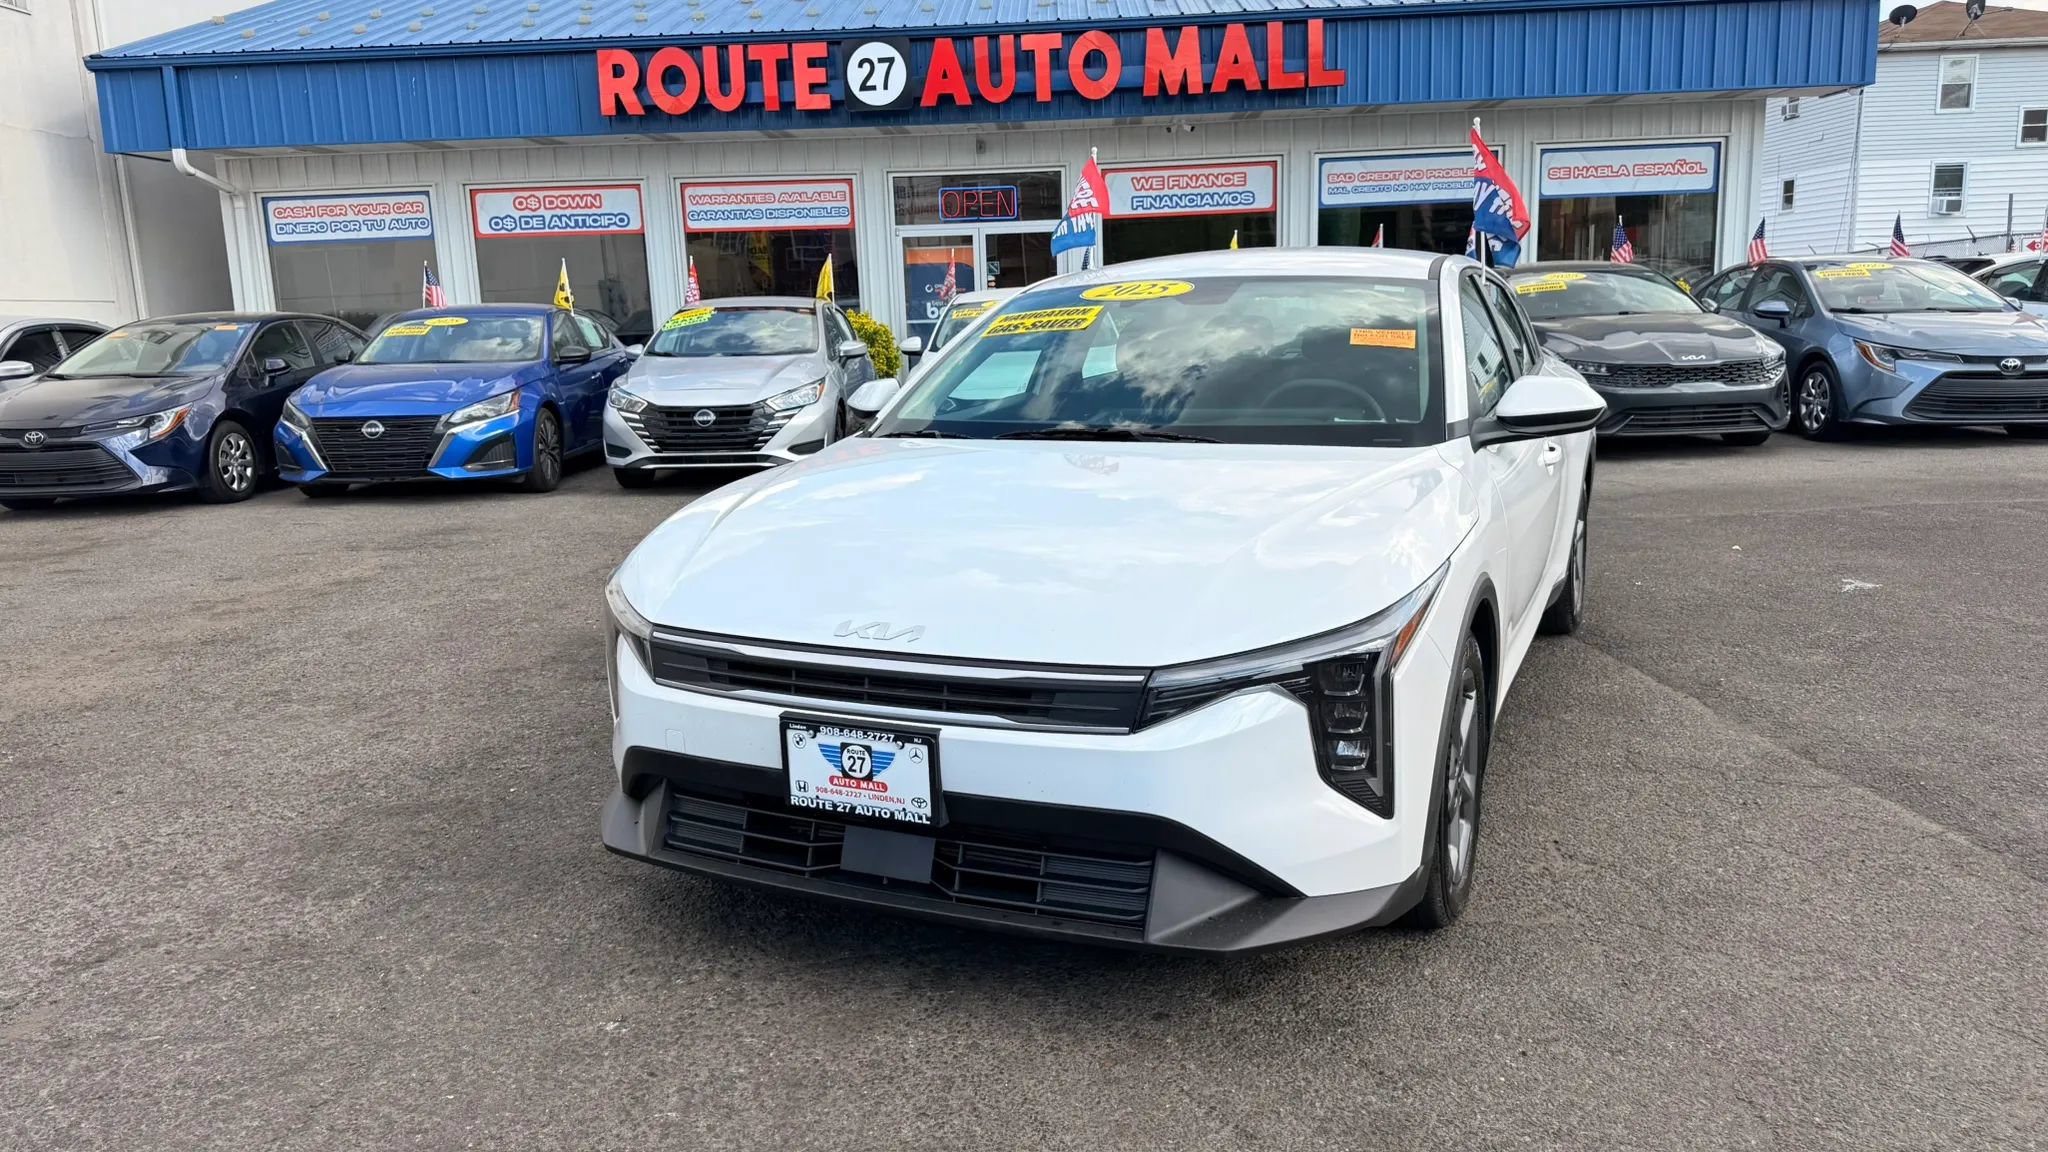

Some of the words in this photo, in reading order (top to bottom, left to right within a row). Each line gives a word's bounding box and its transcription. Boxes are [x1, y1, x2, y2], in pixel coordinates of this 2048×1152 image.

[596, 42, 832, 116] ROUTE
[857, 56, 896, 92] 27
[920, 30, 1122, 107] AUTO
[1143, 18, 1346, 97] MALL
[1328, 173, 1355, 184] BAD
[1357, 171, 1402, 182] CREDIT
[1404, 170, 1424, 180] NO
[1426, 167, 1475, 178] PROBLE
[1548, 168, 1571, 180] SE
[1573, 165, 1629, 179] HABLA
[1632, 158, 1707, 176] ESPAÑOL
[1131, 175, 1165, 191] WE
[1167, 172, 1247, 189] FINANCE
[1328, 186, 1350, 195] MAL
[1351, 184, 1392, 194] CREDITO
[1393, 184, 1408, 192] NO
[1410, 183, 1431, 191] HAY
[544, 193, 602, 210] DOWN
[689, 192, 775, 206] WARRANTIES
[778, 190, 847, 204] AVAILABLE
[941, 191, 1015, 217] OPEN
[1131, 191, 1255, 210] FINANCIAMOS
[274, 205, 315, 219] CASH
[318, 204, 347, 217] FOR
[351, 202, 390, 215] YOUR
[393, 201, 424, 214] CAR
[688, 207, 764, 221] GARANTIAS
[765, 206, 849, 219] DISPONIBLES
[276, 221, 329, 235] DINERO
[330, 219, 361, 233] POR
[363, 219, 386, 231] TU
[388, 217, 430, 230] AUTO
[519, 214, 546, 230] DE
[547, 212, 630, 229] ANTICIPO
[1096, 282, 1178, 297] 2025
[999, 307, 1094, 323] NAVIGATION
[820, 726, 895, 743] 908-648-2727
[846, 748, 866, 756] ROUTE
[847, 756, 866, 774] 27
[815, 786, 862, 799] 908-648-2727
[832, 777, 857, 788] AUTO
[860, 781, 885, 792] MALL
[790, 795, 834, 811] ROUTE
[836, 802, 852, 813] 27
[855, 805, 891, 819] AUTO
[894, 809, 931, 824] MALL
